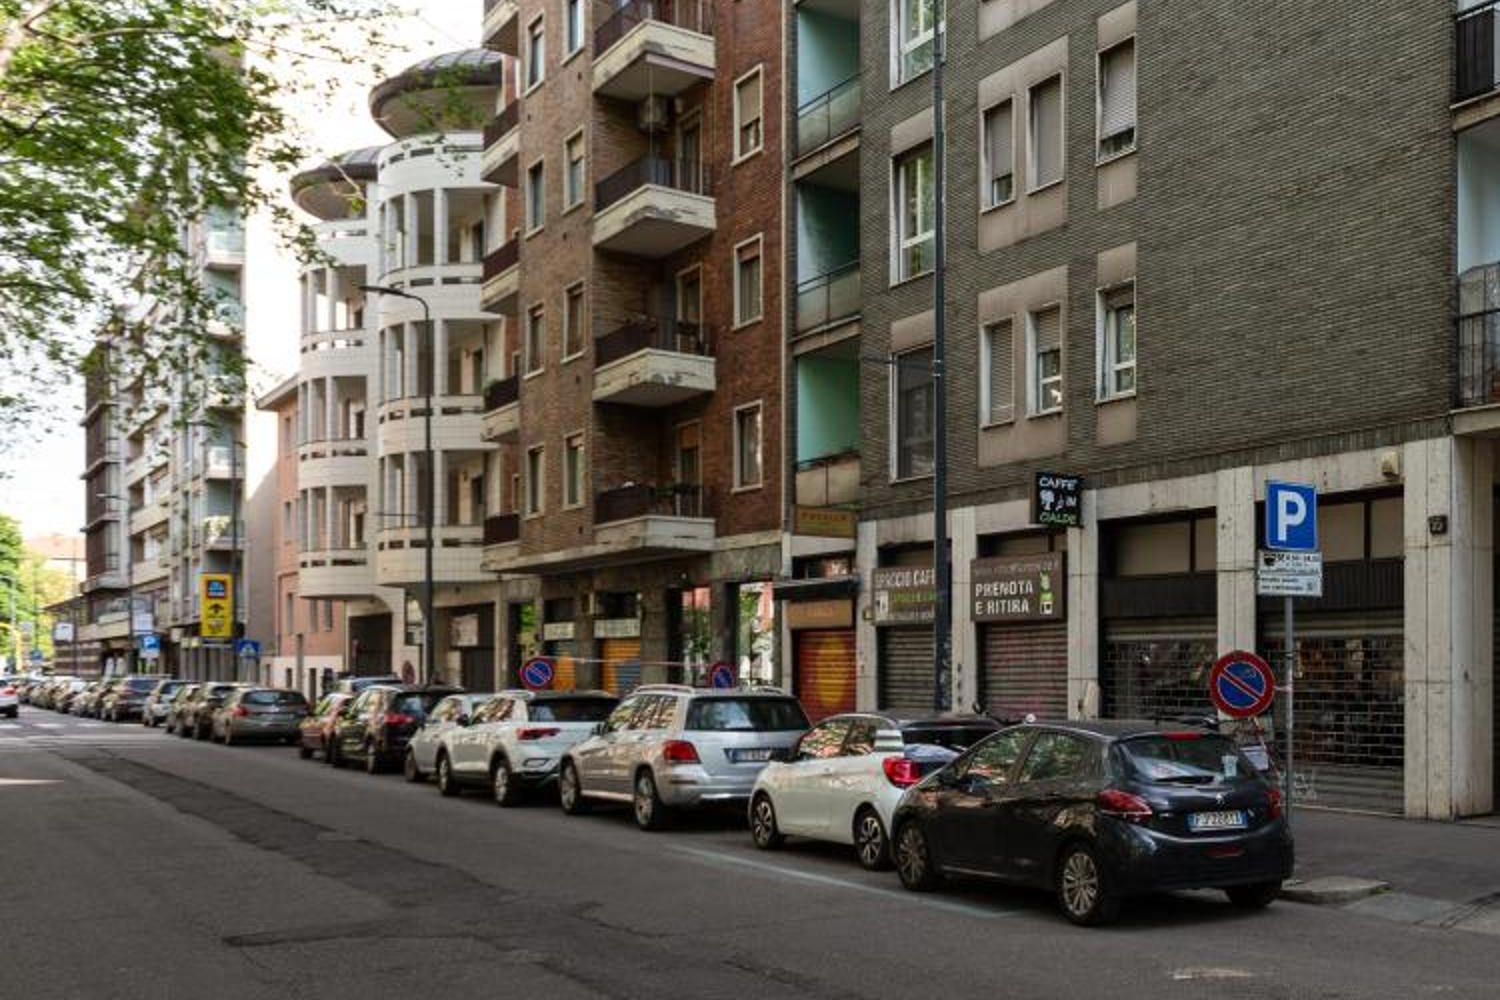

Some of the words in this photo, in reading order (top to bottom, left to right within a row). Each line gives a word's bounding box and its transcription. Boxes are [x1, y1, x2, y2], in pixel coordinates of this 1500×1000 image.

[1277, 489, 1307, 541] P
[975, 580, 1034, 597] PRENOTA
[975, 601, 983, 615] E
[987, 599, 1031, 614] RITIRA
